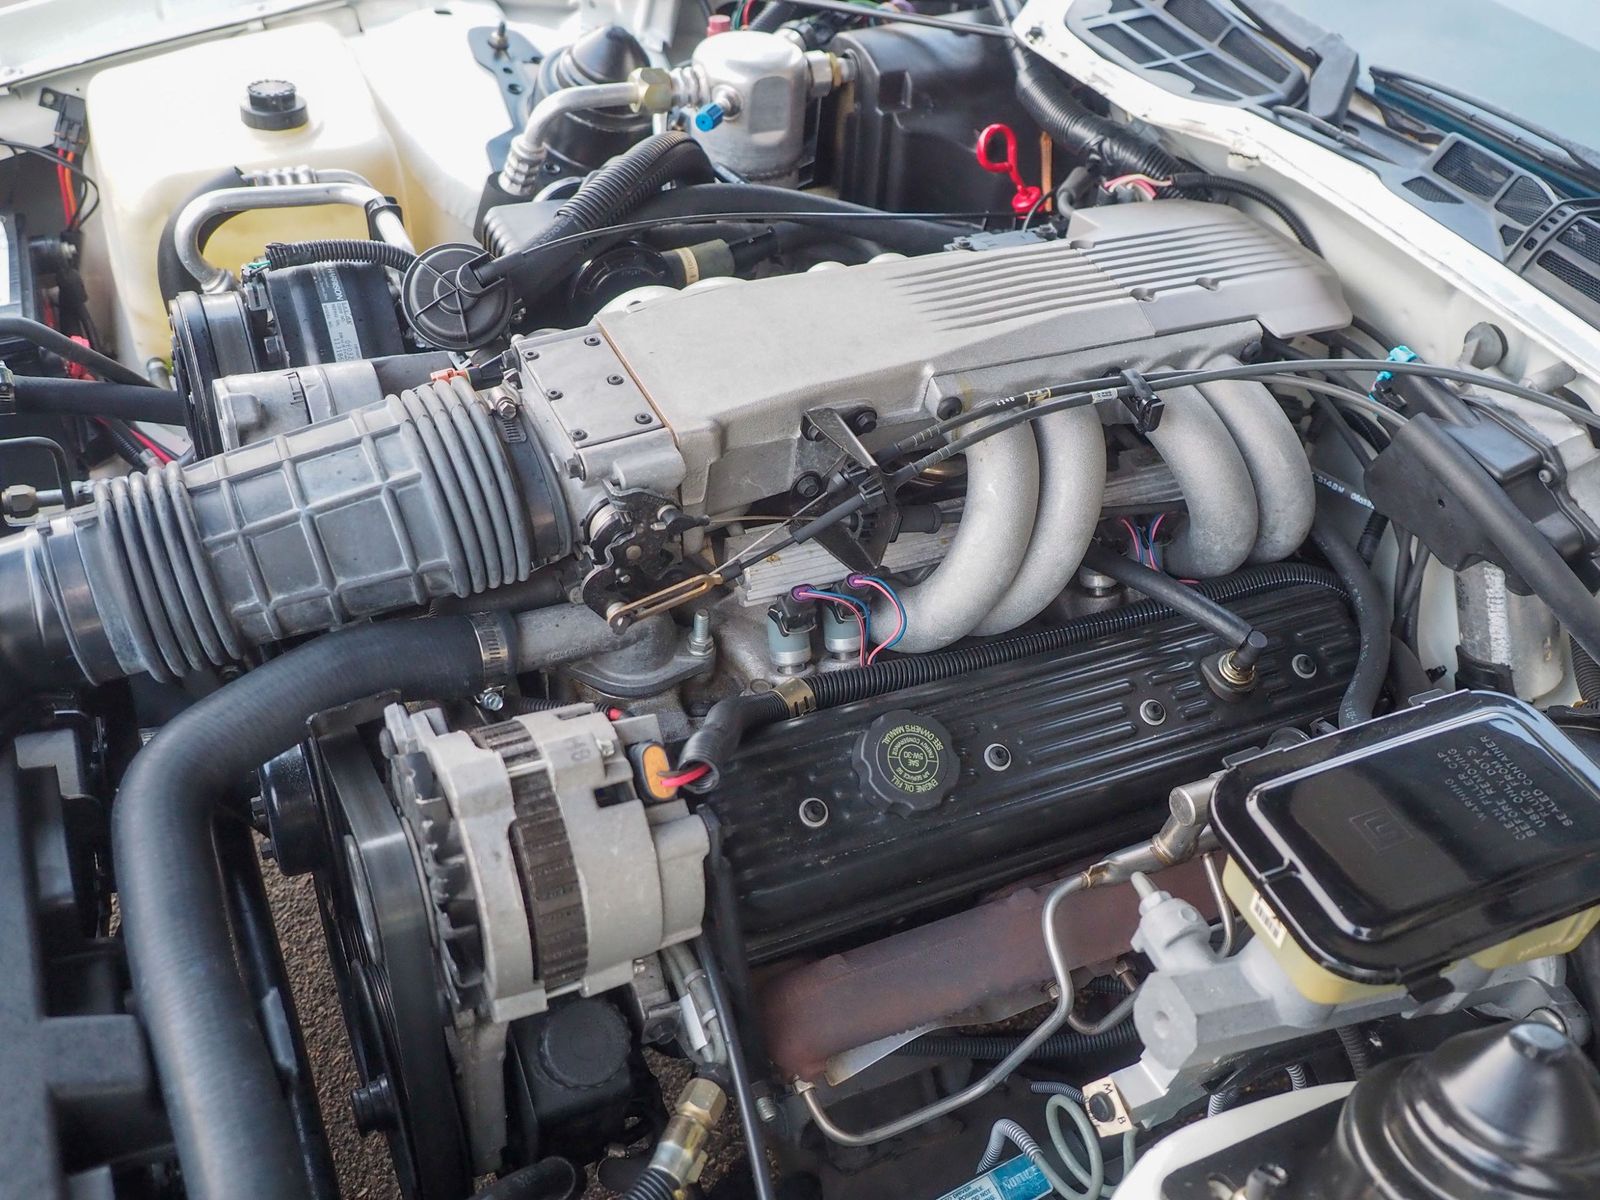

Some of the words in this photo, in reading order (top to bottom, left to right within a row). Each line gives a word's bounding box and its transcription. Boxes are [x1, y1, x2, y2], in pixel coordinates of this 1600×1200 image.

[882, 726, 905, 744] MANUAL
[904, 724, 934, 740] OWNER'S
[933, 737, 944, 751] SEE
[903, 751, 923, 760] 5W-30
[907, 759, 920, 767] SAE
[1436, 752, 1458, 769] CAP
[1474, 757, 1496, 775] DOT
[1479, 735, 1534, 786] CONTAINER
[891, 775, 903, 788] FILL
[1448, 748, 1496, 795] REMOVING
[1489, 760, 1520, 786] FROM
[904, 784, 914, 792] OIL
[916, 779, 939, 793] ENGINE
[1456, 773, 1492, 805] FILLER
[1495, 779, 1524, 804] ONLY
[1444, 778, 1487, 821] WARNING
[1520, 789, 1550, 817] FLUID
[1532, 788, 1574, 827] SEALED
[1490, 808, 1526, 840] CLEAN
[1495, 799, 1537, 837] BEFORE
[1521, 807, 1546, 828] USE
